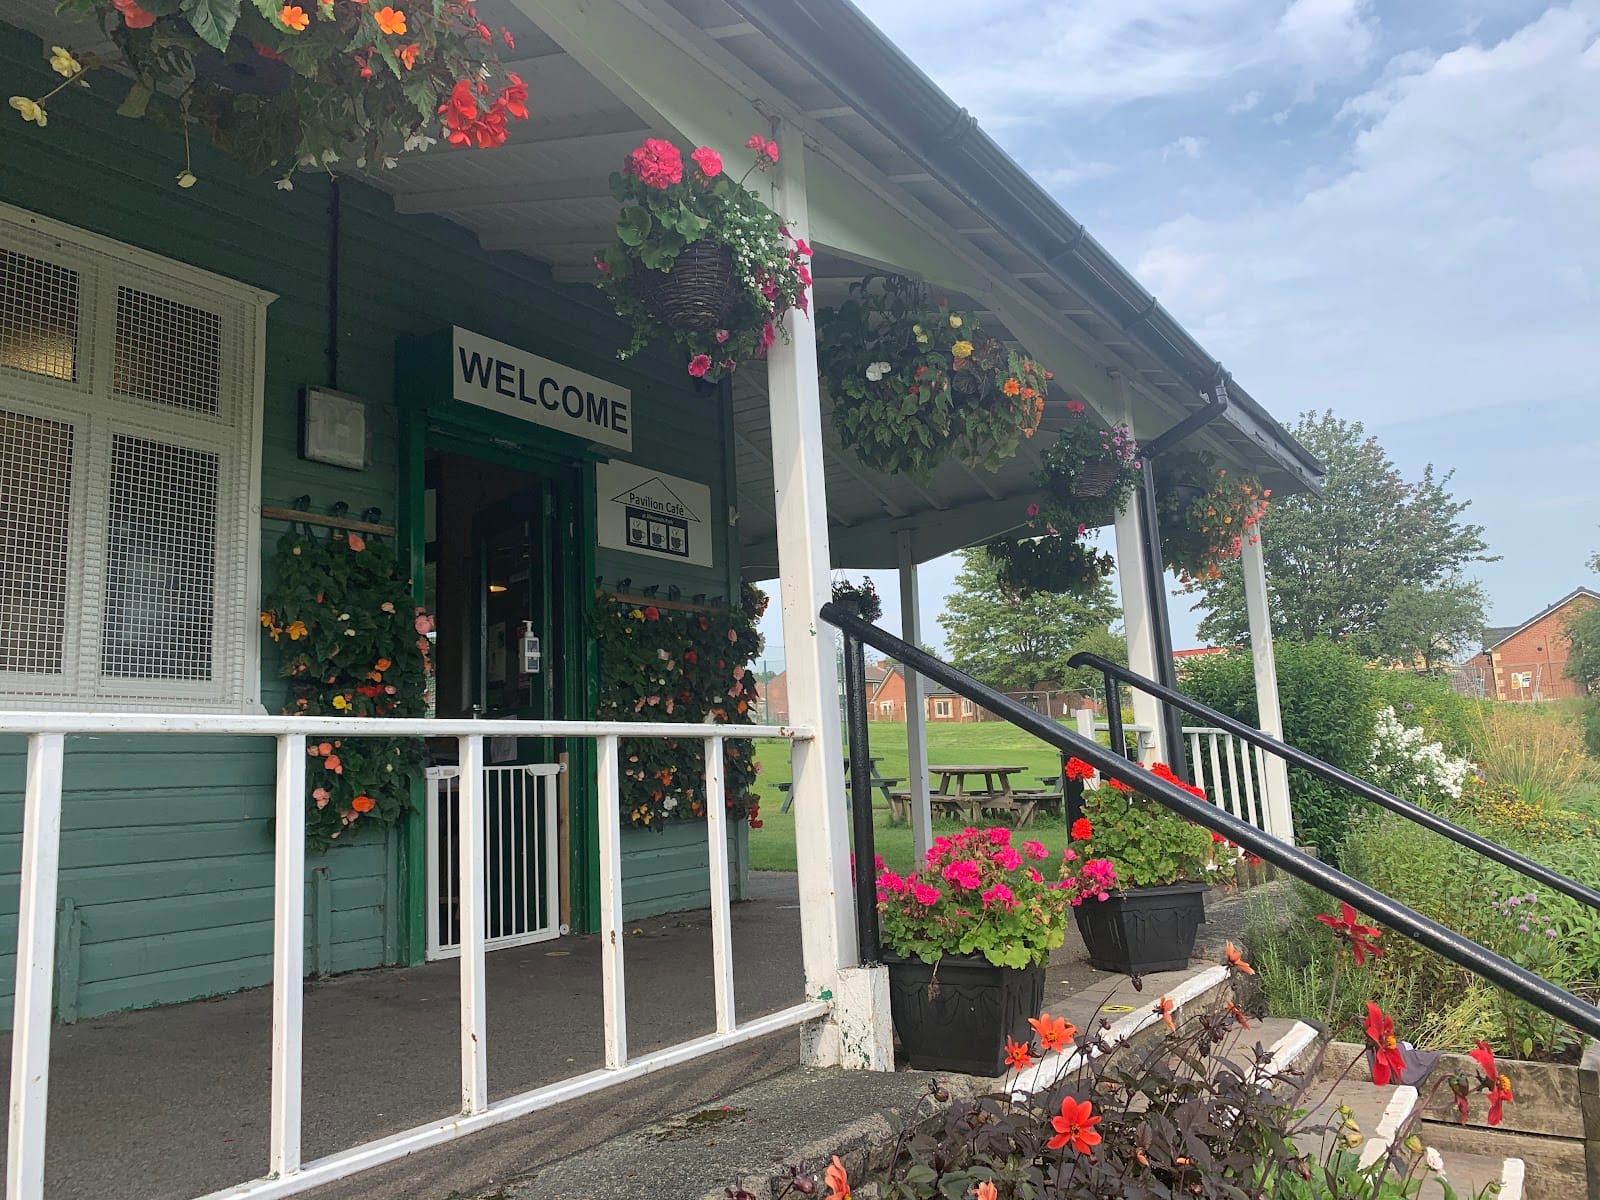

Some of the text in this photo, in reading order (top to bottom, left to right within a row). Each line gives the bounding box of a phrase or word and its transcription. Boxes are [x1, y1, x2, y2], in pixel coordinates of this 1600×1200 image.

[459, 346, 628, 434] WELCOME
[629, 492, 684, 516] Pavilion Café
